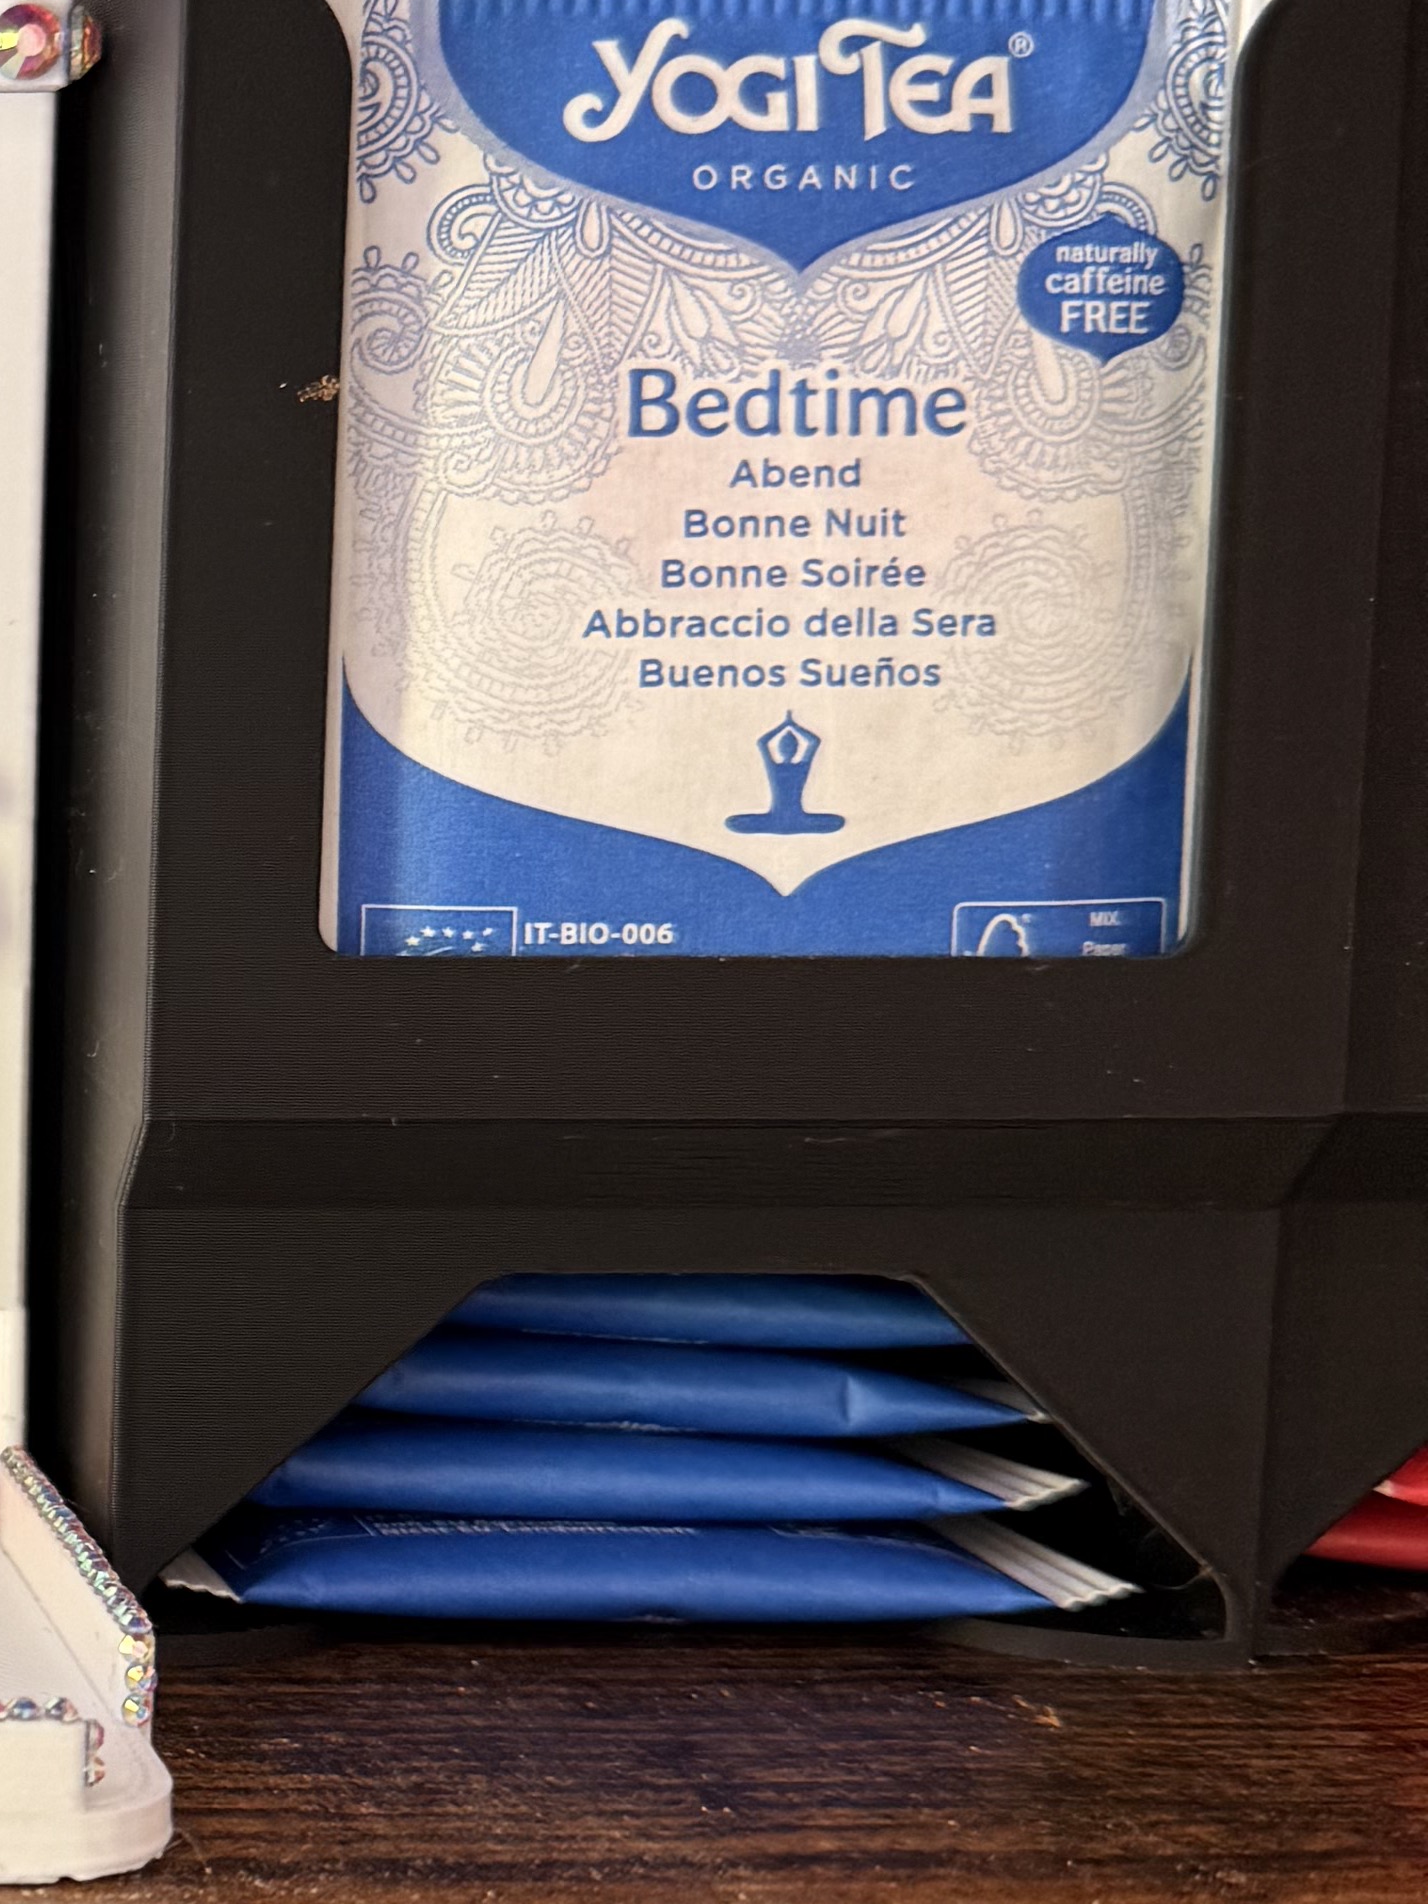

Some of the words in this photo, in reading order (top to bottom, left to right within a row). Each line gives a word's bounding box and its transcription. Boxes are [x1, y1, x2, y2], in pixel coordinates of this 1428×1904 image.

[562, 17, 820, 143] YOGI
[692, 164, 917, 192] ORGANIC
[1055, 241, 1160, 271] naturally
[1044, 265, 1168, 296] caffeine
[1059, 299, 1151, 334] FREE
[626, 367, 968, 438] Bedtime
[729, 458, 863, 489] Abend
[682, 508, 812, 539] Bonne
[824, 507, 907, 538] Nuit
[660, 558, 789, 589] Bonne
[800, 555, 928, 589] Soirée
[581, 607, 792, 639] Abbraccio
[802, 606, 900, 638] della
[910, 607, 998, 638] Sera
[638, 657, 787, 689] Buenos
[799, 656, 942, 688] Sueños
[523, 921, 676, 946] IT-BIO-006
